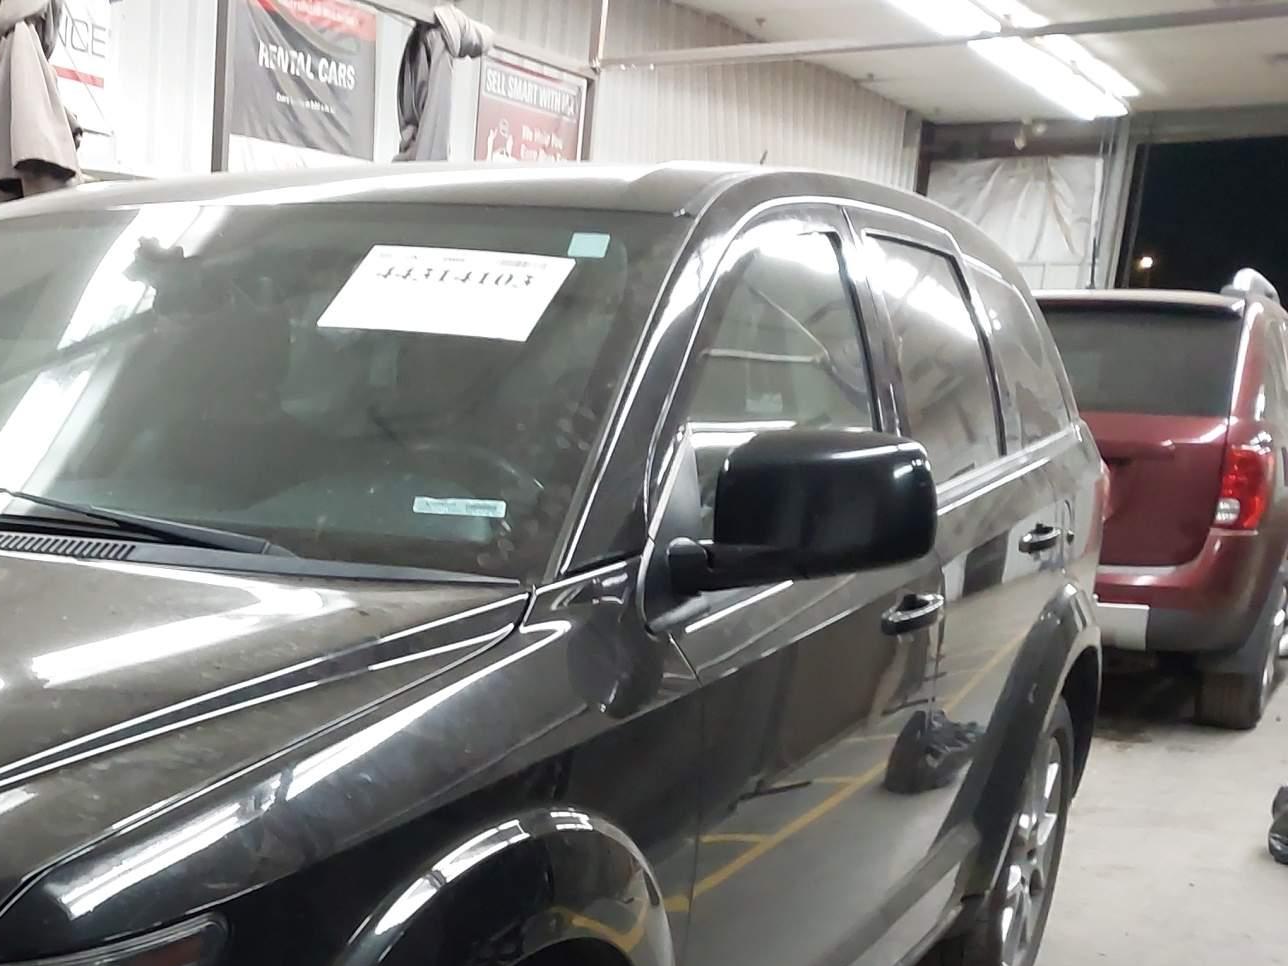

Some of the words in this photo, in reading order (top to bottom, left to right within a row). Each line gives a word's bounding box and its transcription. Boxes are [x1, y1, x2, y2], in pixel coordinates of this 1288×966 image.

[258, 39, 315, 80] RENTAL
[318, 57, 357, 91] CARS
[486, 68, 506, 95] SELL
[507, 76, 538, 105] SMART
